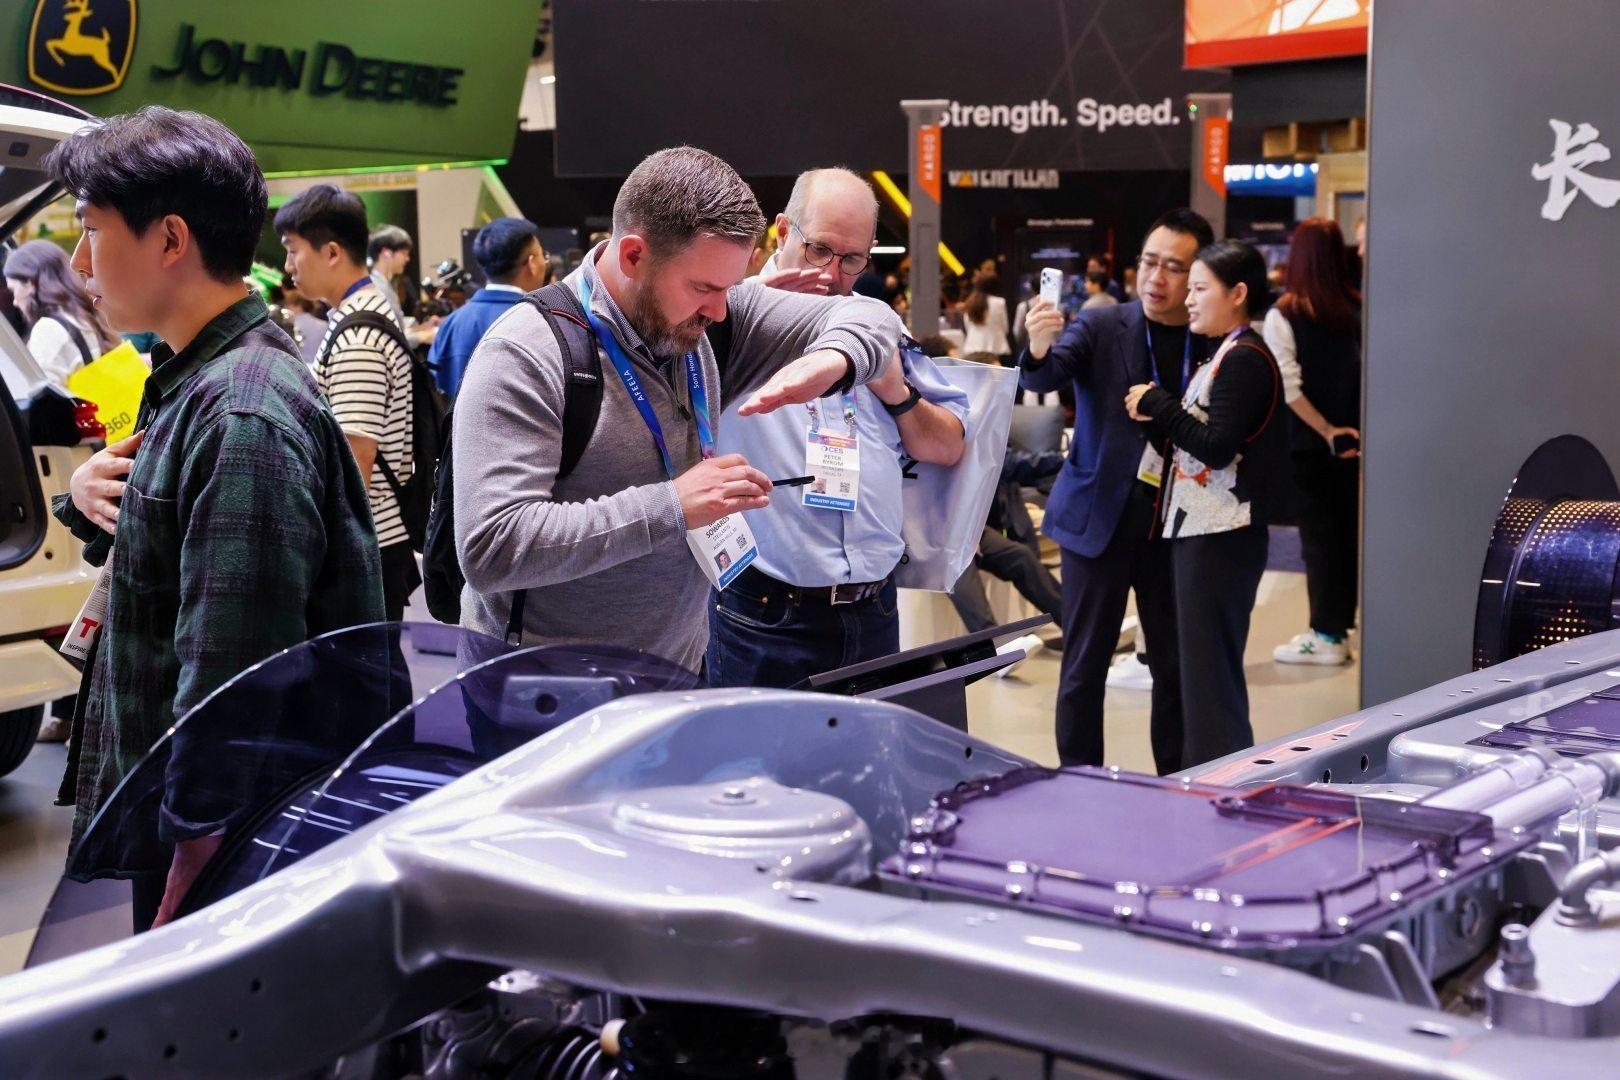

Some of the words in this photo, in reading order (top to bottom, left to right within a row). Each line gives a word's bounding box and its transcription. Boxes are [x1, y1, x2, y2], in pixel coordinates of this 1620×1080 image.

[151, 23, 306, 90] JOHN
[309, 40, 465, 108] DEERE
[1076, 97, 1181, 133] Speed.
[1531, 118, 1620, 222] 长
[623, 369, 645, 401] AFEELA
[691, 373, 700, 389] Sony
[106, 411, 132, 436] 360
